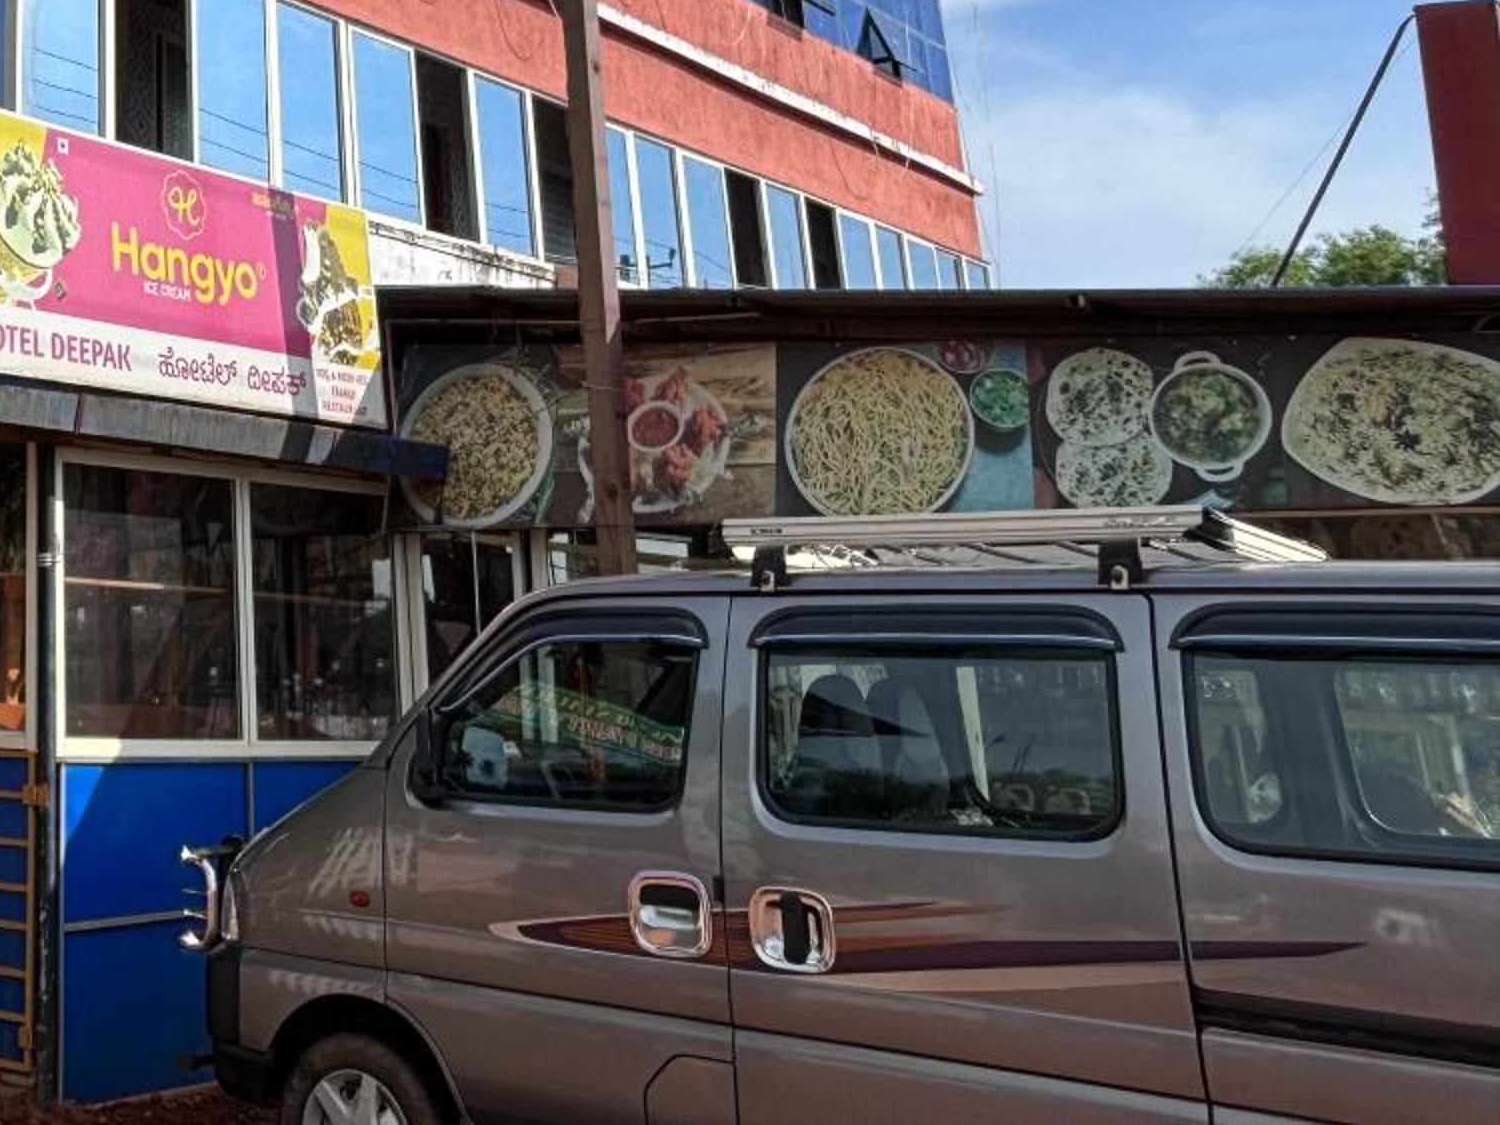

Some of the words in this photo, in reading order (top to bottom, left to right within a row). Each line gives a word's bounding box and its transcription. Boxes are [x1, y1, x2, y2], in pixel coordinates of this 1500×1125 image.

[111, 221, 258, 306] Hangyo
[143, 280, 160, 296] ICE
[160, 283, 192, 301] CREAM
[51, 332, 133, 372] DEEPAK
